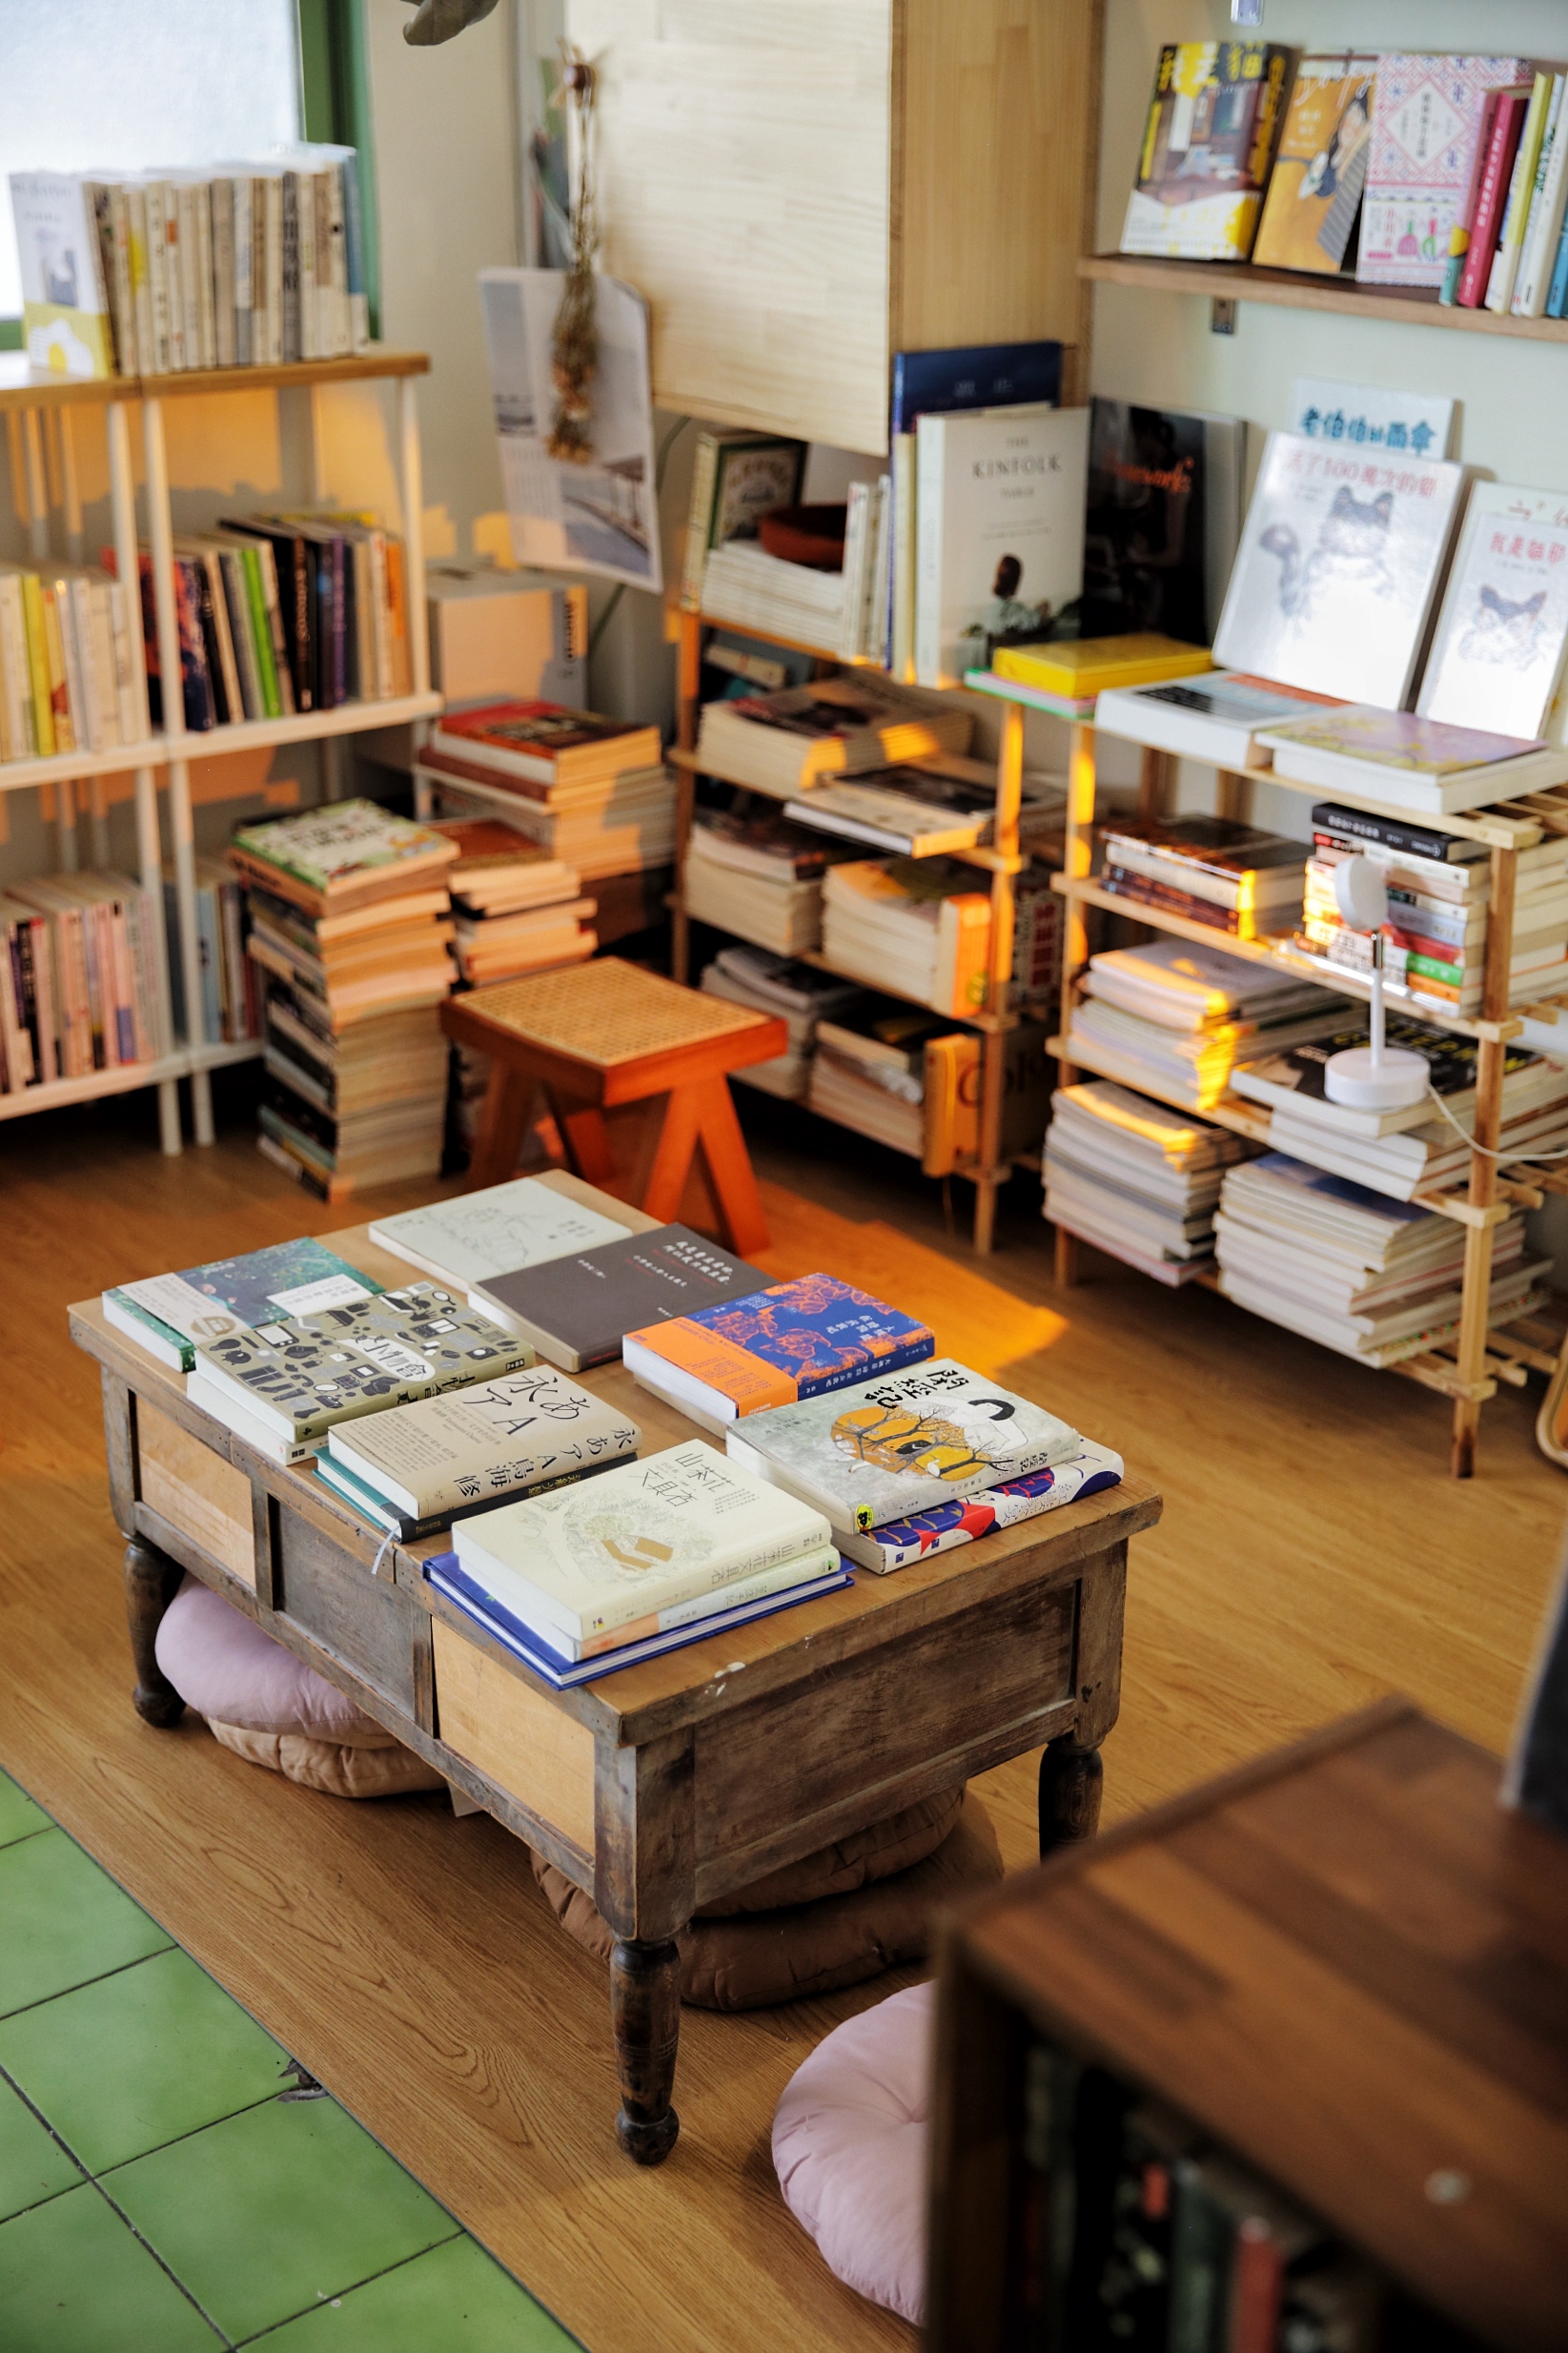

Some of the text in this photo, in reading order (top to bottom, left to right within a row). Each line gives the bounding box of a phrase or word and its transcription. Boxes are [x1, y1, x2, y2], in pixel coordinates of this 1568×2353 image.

[971, 452, 1064, 481] KINFOLK
[628, 1467, 699, 1507] 文具店
[674, 1452, 736, 1494] 山茶花
[711, 1542, 796, 1586] 山茶花文具店
